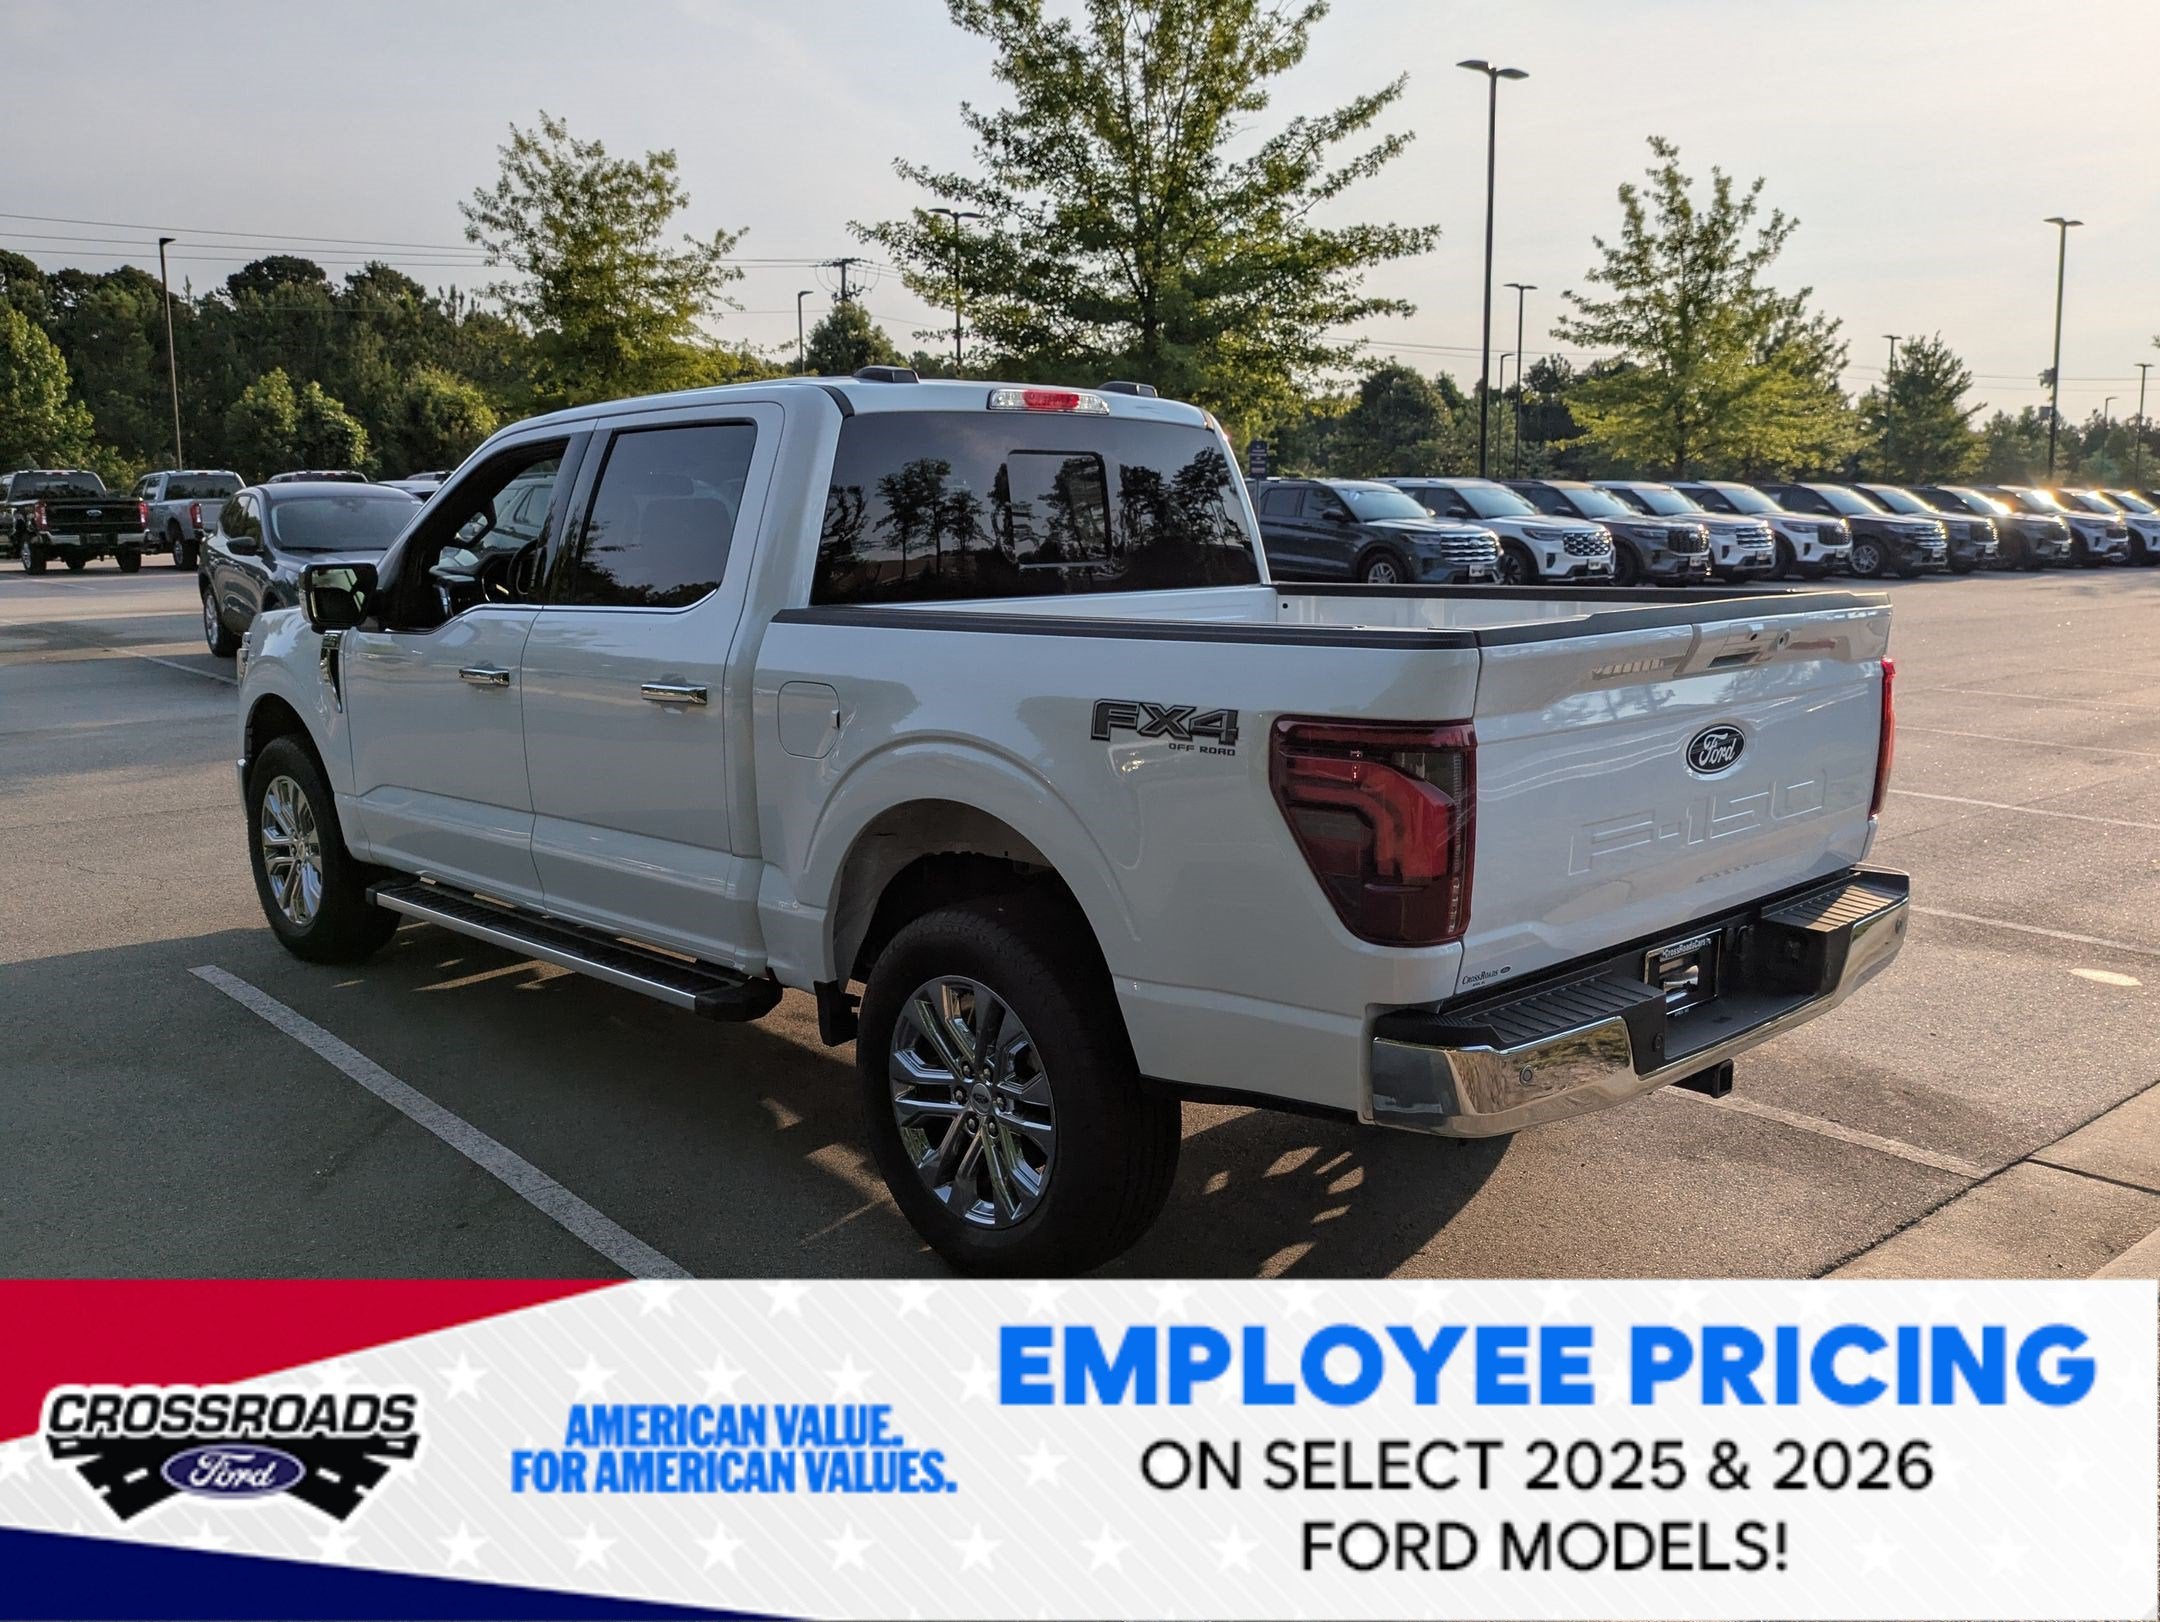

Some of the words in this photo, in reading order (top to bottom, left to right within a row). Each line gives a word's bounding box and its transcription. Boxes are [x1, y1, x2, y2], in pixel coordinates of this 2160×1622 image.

[1091, 698, 1239, 746] FX4
[1168, 742, 1195, 752] OFF
[1200, 745, 1236, 757] ROAD
